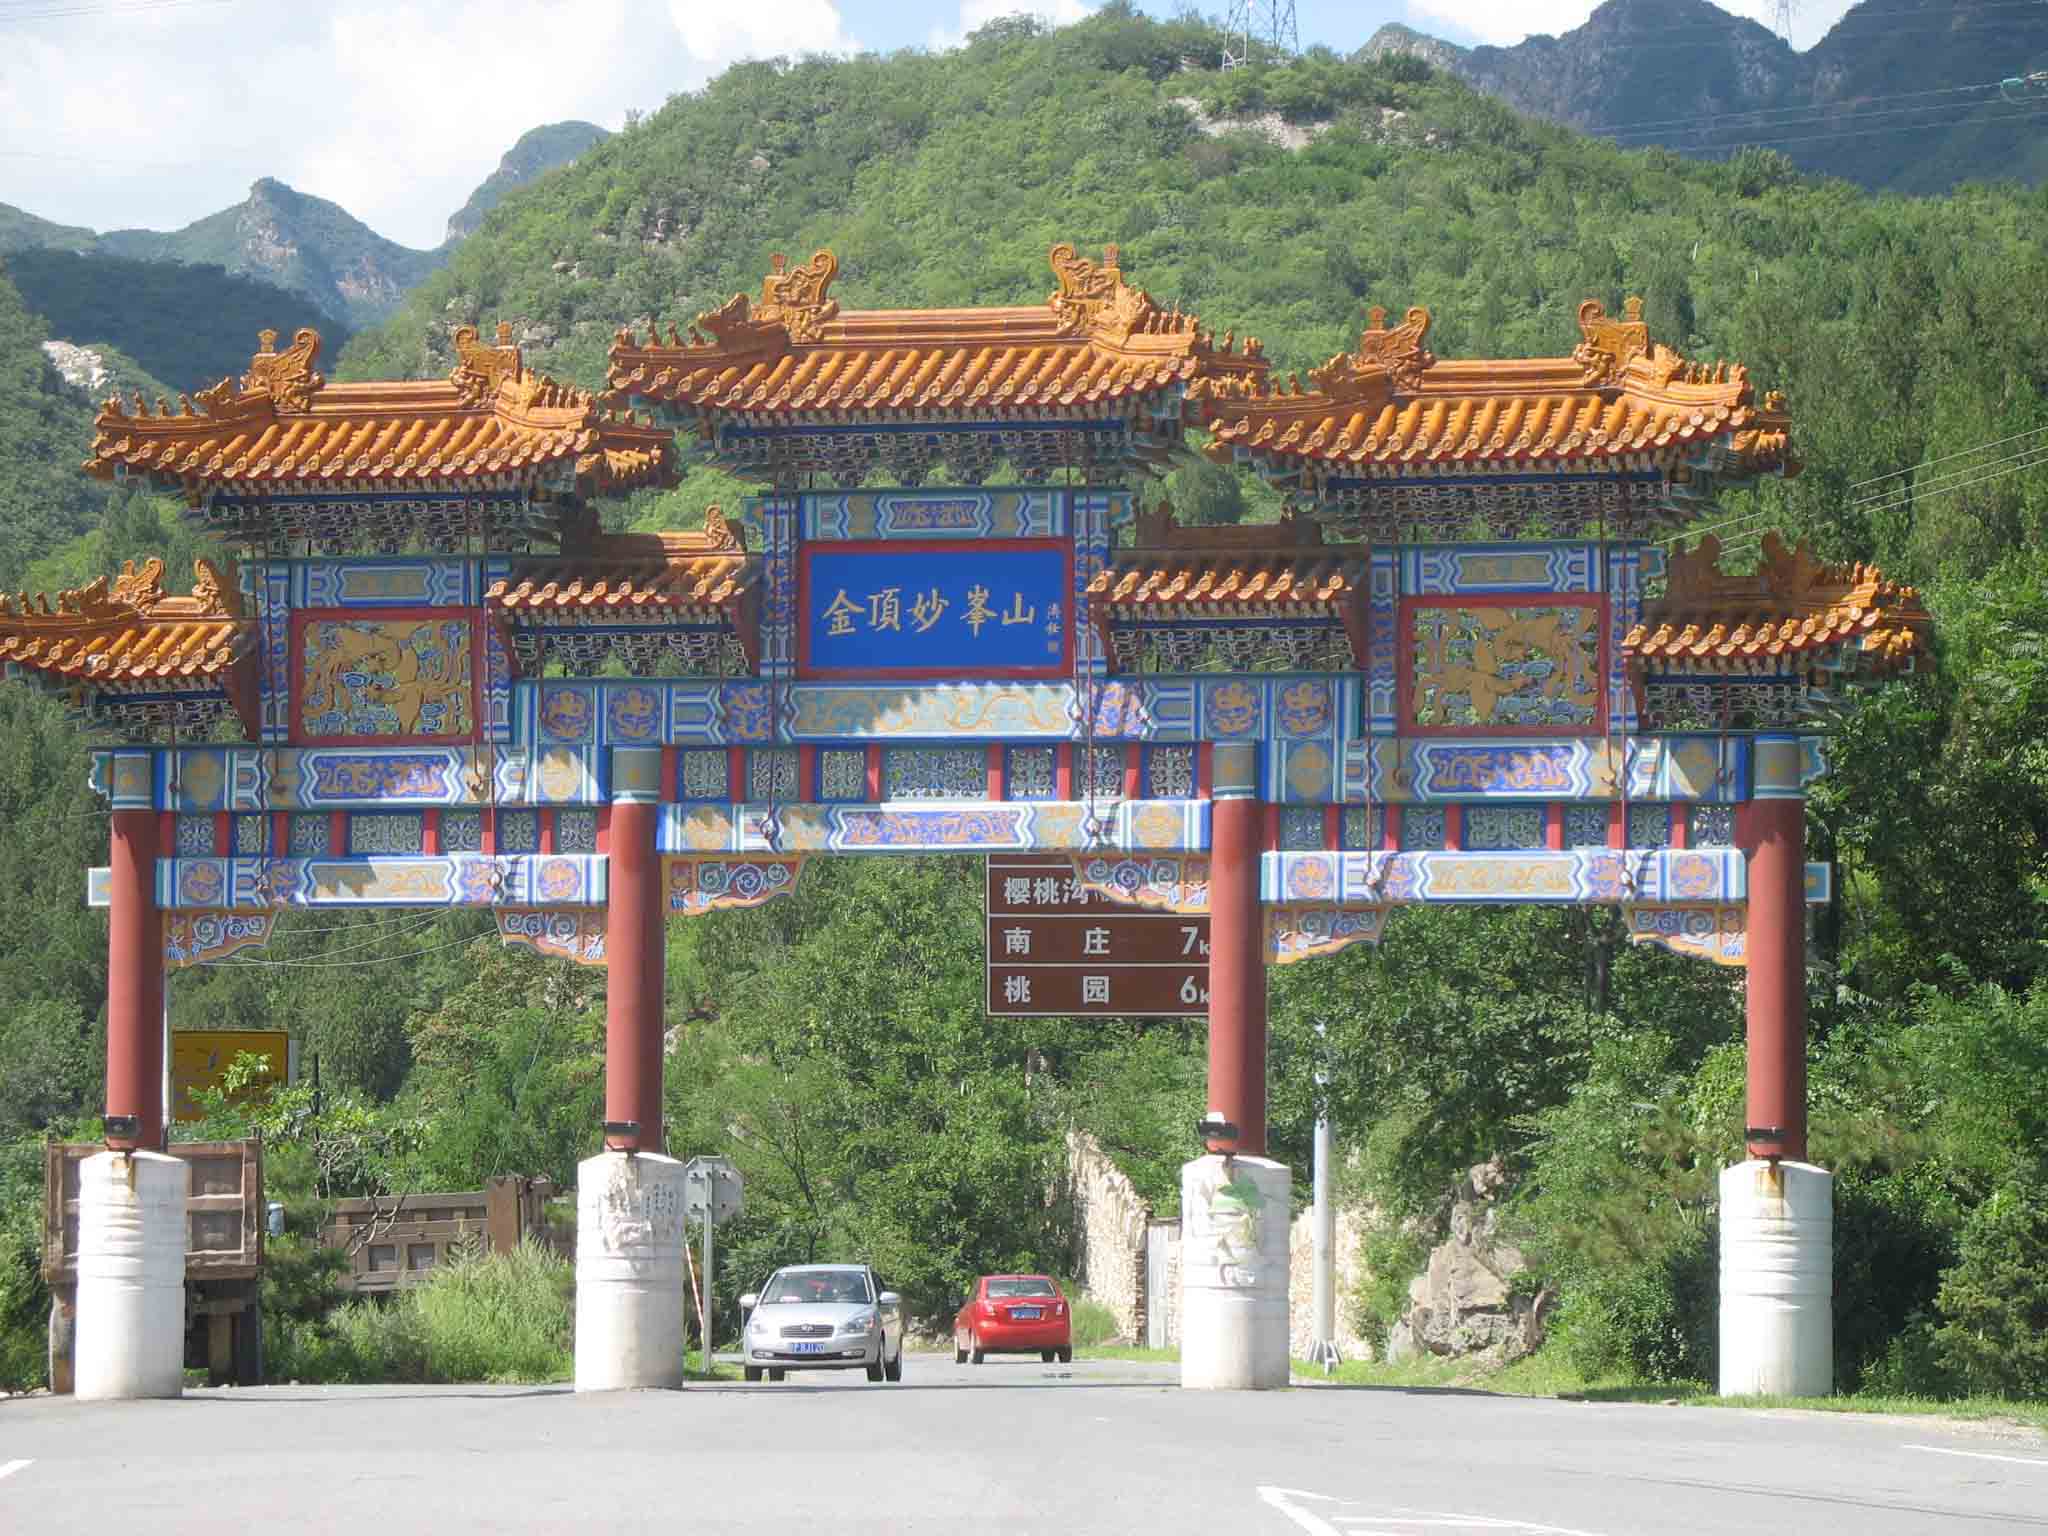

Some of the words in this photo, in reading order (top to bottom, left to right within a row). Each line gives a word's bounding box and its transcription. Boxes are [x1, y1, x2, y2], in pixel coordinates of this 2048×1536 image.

[822, 583, 1035, 638] 金頂妙峯山
[1003, 876, 1112, 905] 樱桃沟
[1180, 926, 1211, 955] 7k
[1180, 975, 1210, 1004] 6k
